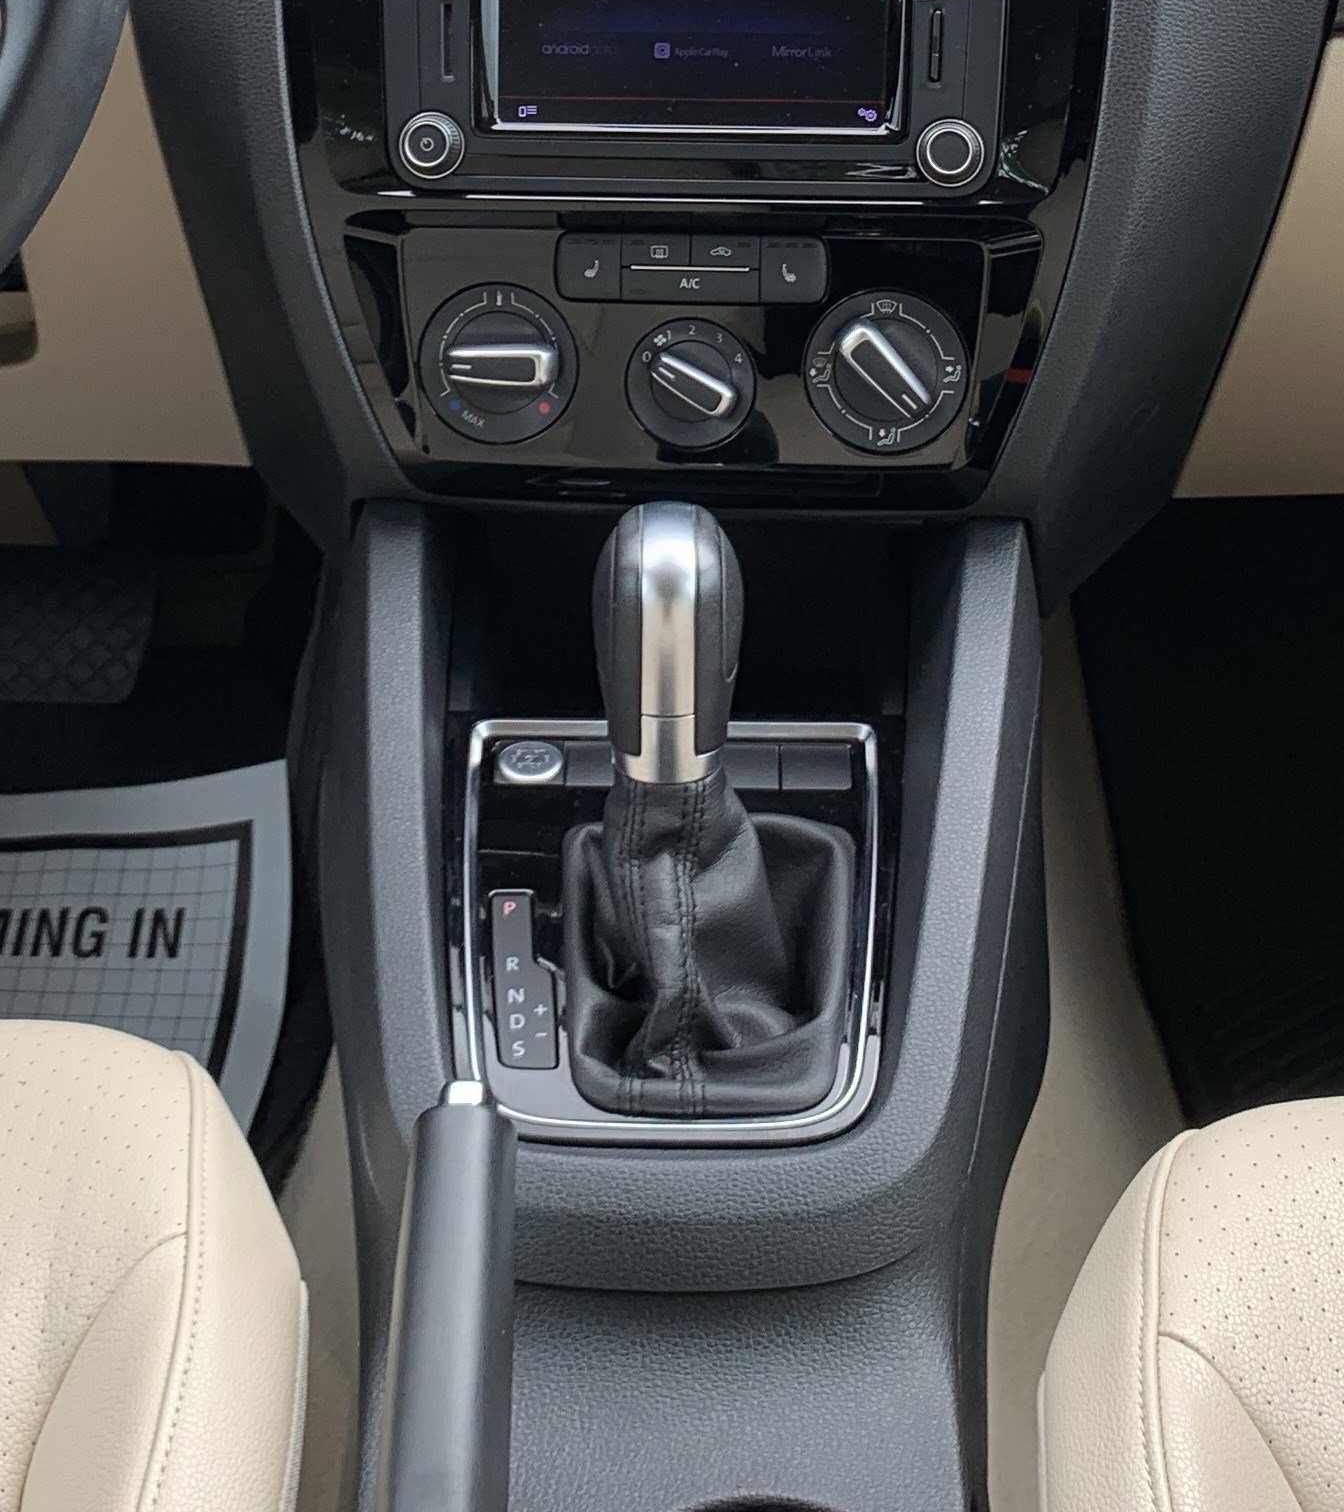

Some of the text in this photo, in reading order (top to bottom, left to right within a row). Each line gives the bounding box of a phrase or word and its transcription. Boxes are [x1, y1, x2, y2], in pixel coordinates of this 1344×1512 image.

[679, 278, 700, 289] A/C
[666, 330, 672, 340] 1
[689, 325, 696, 335] 2
[717, 333, 723, 343] 3
[734, 353, 743, 363] 4
[461, 410, 486, 428] MAX
[502, 901, 517, 916] P
[127, 906, 186, 959] IN
[506, 956, 519, 971] R
[507, 988, 525, 1003] N
[510, 1013, 526, 1029] D
[512, 1040, 526, 1057] S
